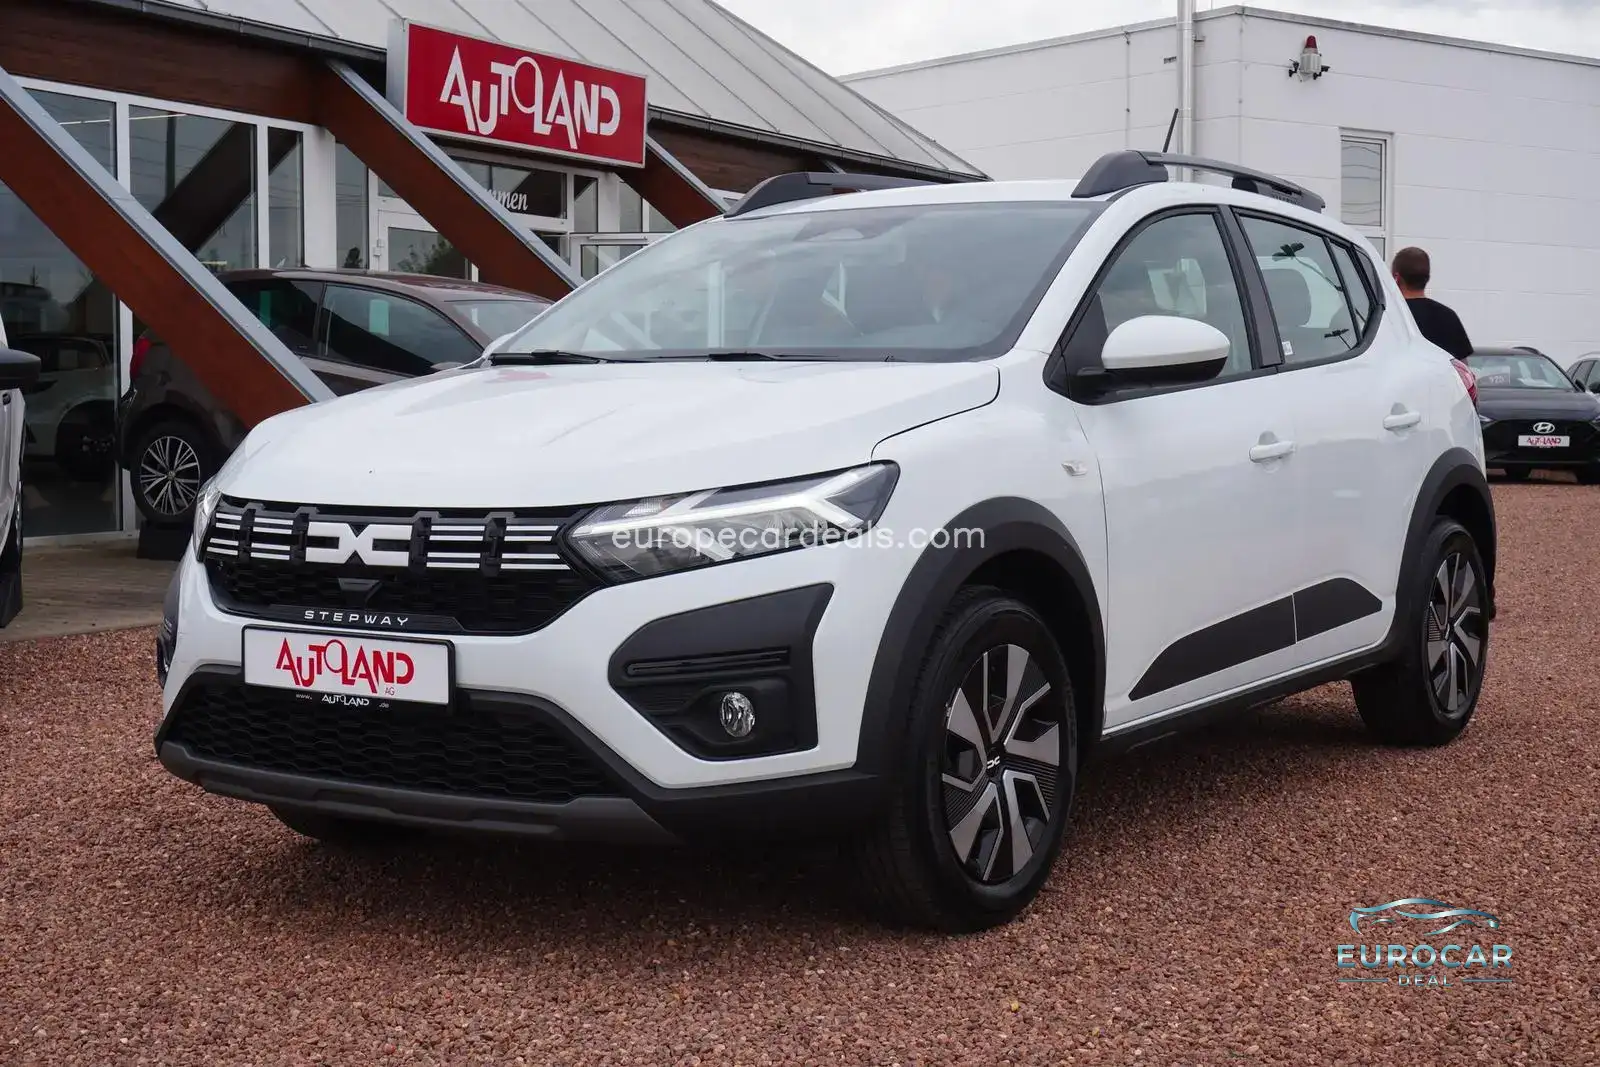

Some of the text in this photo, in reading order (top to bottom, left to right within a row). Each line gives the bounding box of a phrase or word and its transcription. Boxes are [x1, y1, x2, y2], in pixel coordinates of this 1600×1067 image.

[439, 44, 621, 150] AUTOLAND
[304, 610, 409, 626] STEPWAY
[275, 637, 415, 694] AUTOLAND
[385, 687, 395, 696] AG
[322, 694, 370, 707] AUTOLAND
